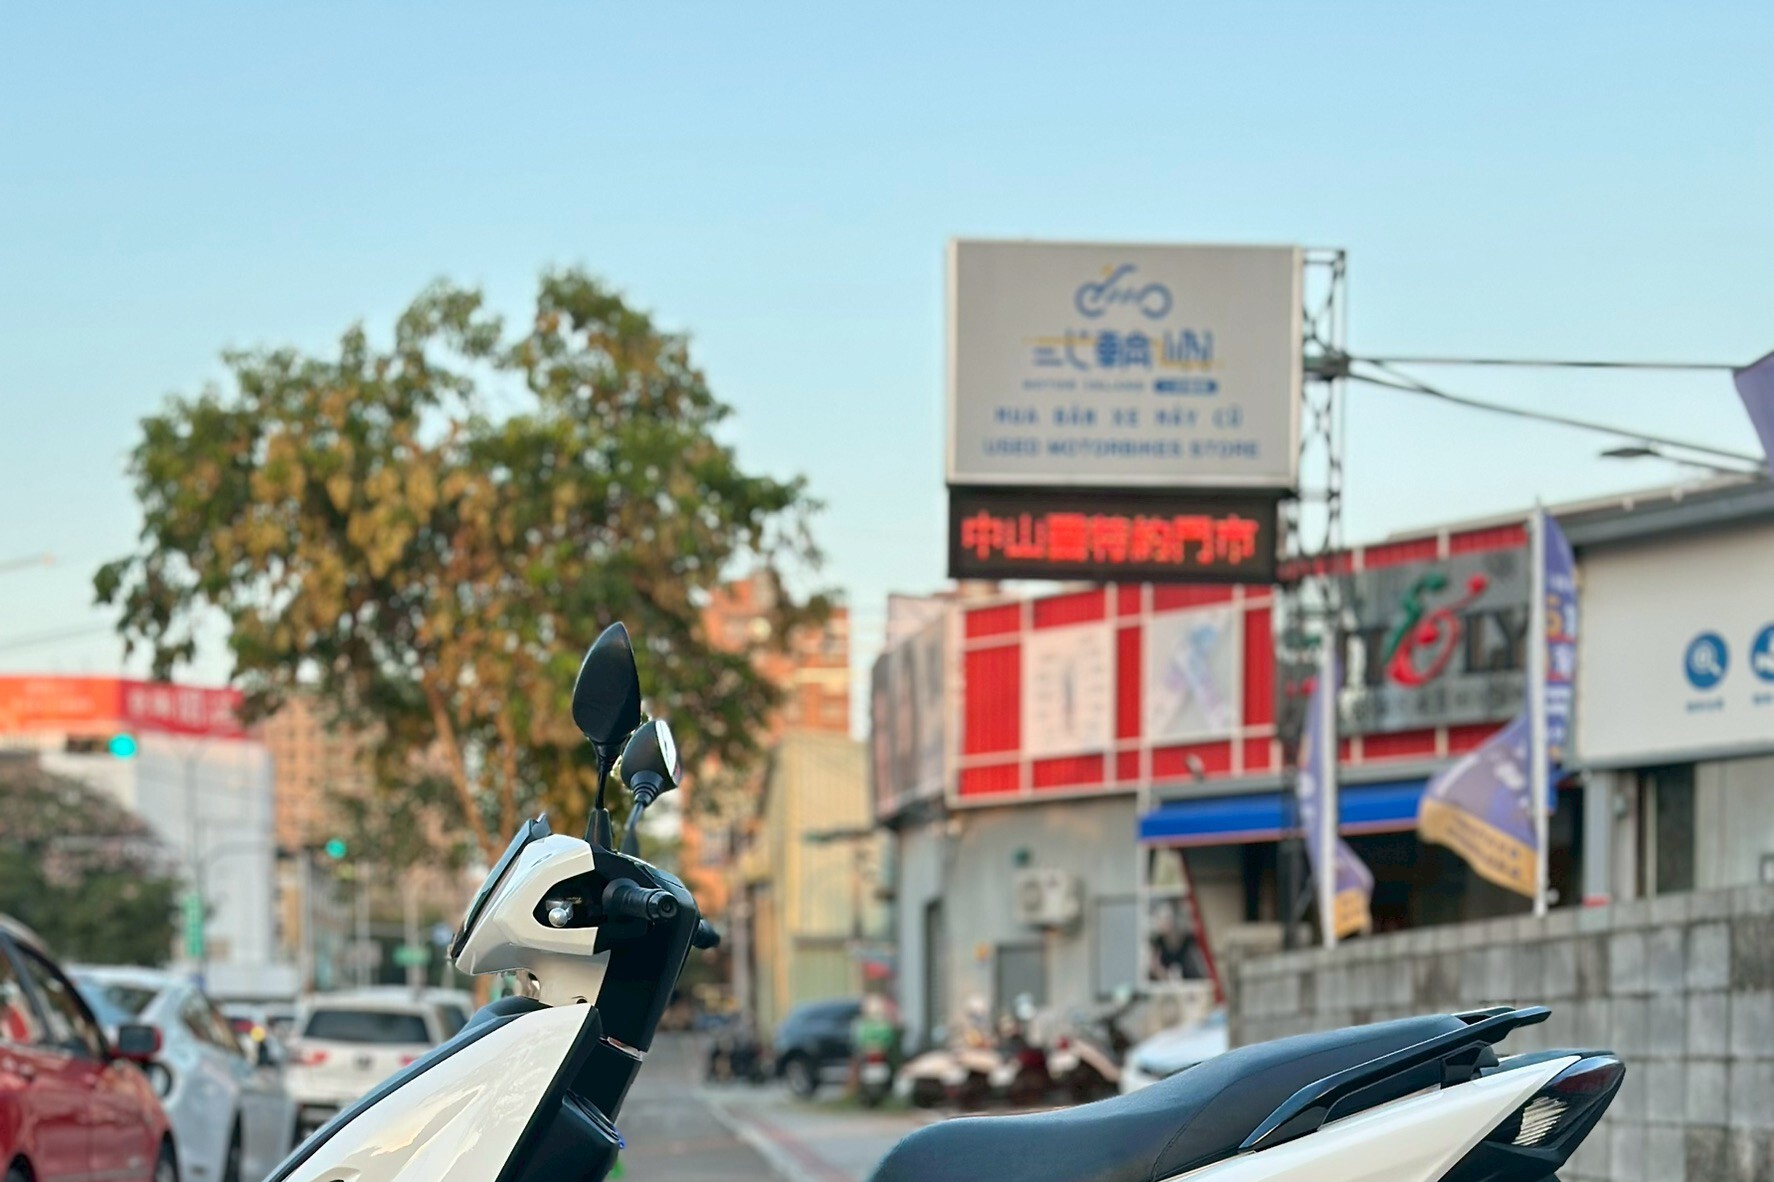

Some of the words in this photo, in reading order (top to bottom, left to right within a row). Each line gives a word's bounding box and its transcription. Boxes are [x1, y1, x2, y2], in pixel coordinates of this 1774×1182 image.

[984, 438, 1039, 456] USED
[1048, 438, 1182, 457] MOTORBIKES
[1190, 438, 1259, 458] STORE
